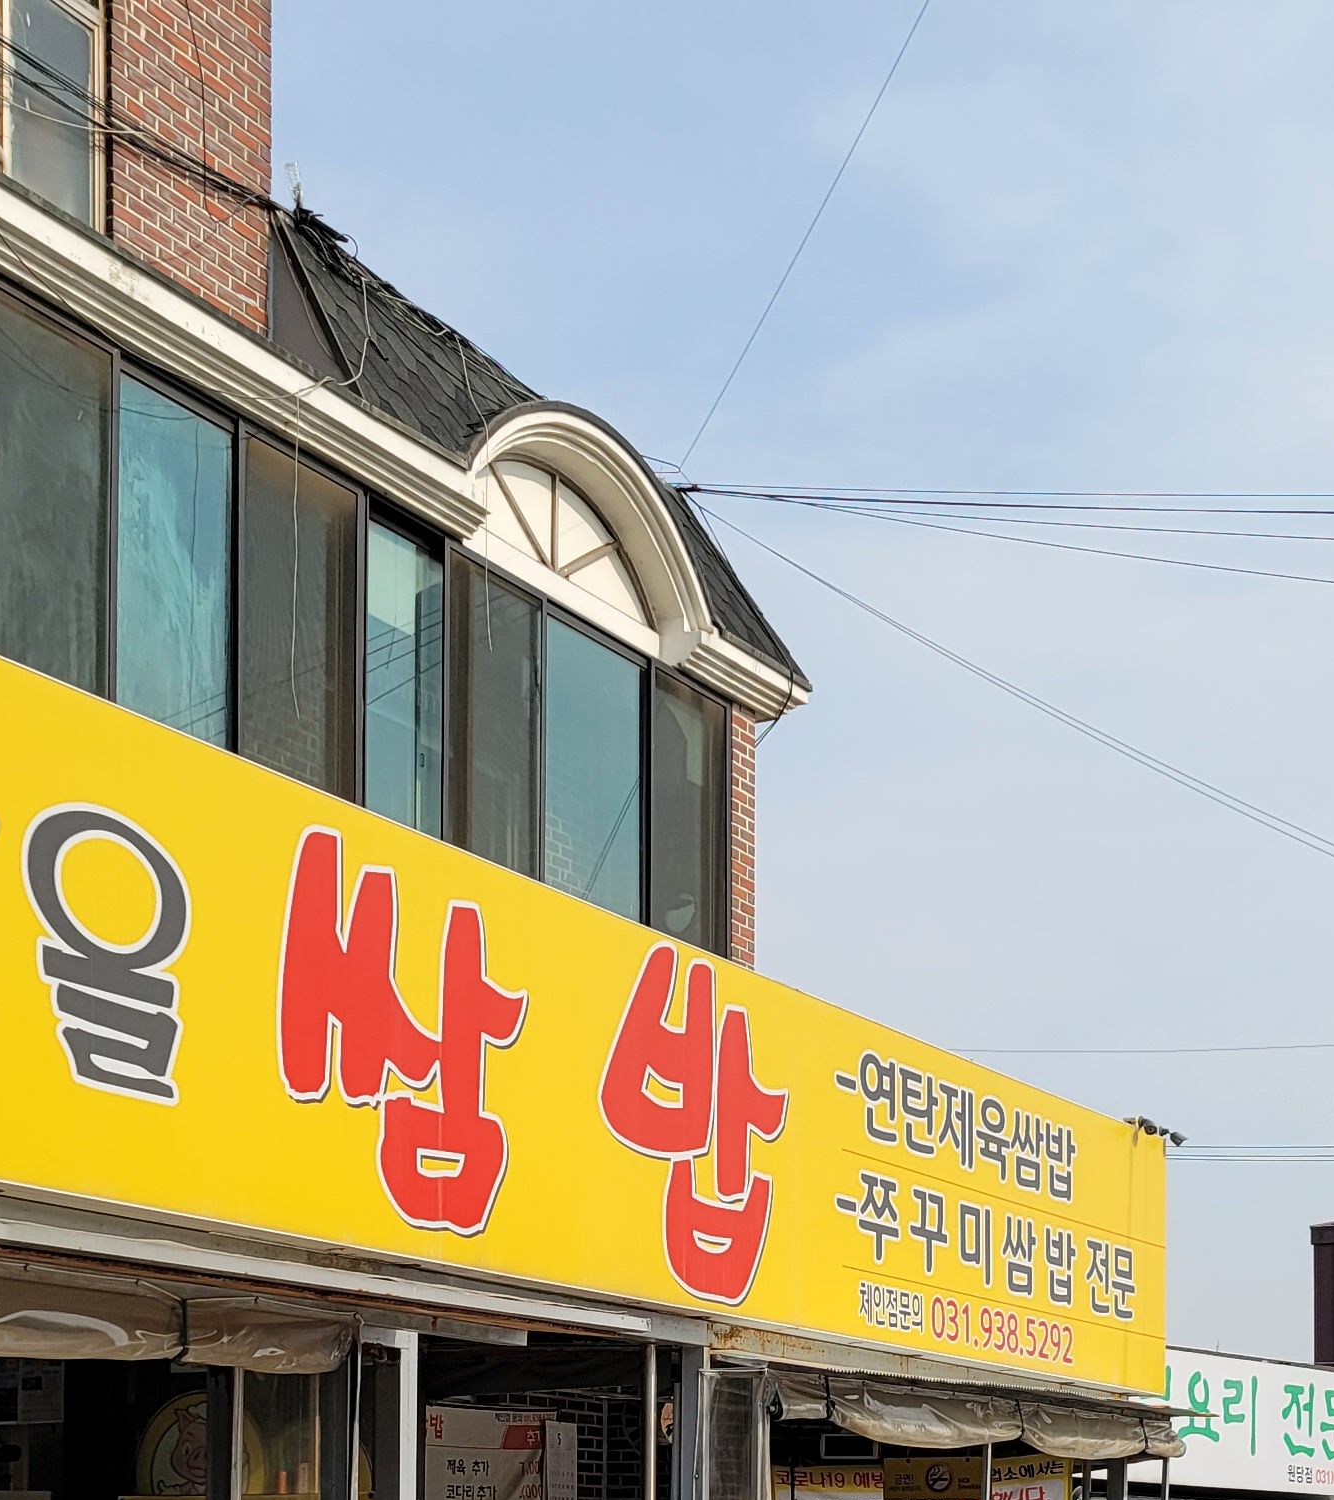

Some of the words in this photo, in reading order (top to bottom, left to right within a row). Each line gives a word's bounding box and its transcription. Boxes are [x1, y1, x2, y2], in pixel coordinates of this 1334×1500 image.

[277, 824, 789, 1306] 쌈밥
[1084, 1237, 1137, 1321] 전문
[857, 1280, 925, 1334] 체인점문의
[929, 1293, 1075, 1365] 031.938.5292
[446, 1458, 467, 1476] 제육
[471, 1459, 491, 1477] 추가
[1287, 1464, 1314, 1485] 원당점
